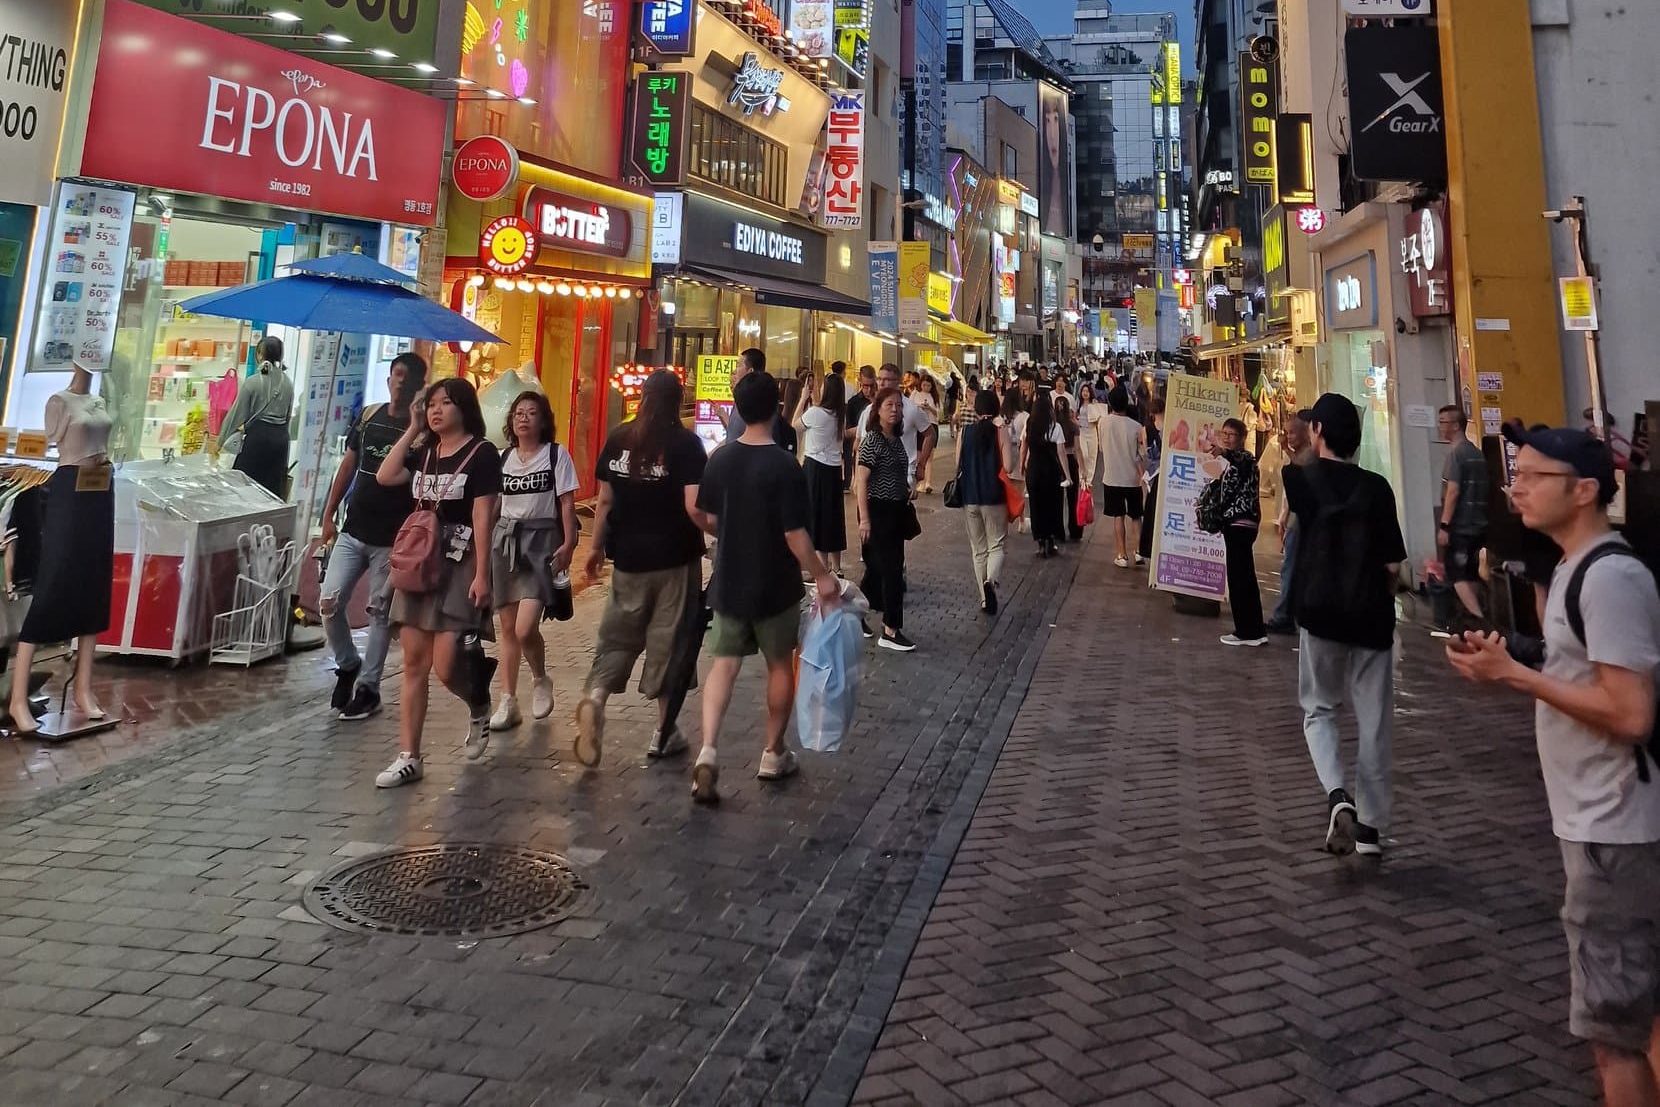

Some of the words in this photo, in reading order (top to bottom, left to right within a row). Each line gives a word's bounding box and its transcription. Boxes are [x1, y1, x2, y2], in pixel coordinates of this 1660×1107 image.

[639, 46, 653, 58] 1F
[648, 78, 676, 94] 루키
[1251, 68, 1270, 158] momo
[200, 75, 378, 182] EPONA
[646, 97, 671, 174] 노래방
[460, 158, 507, 171] EPONA
[827, 112, 861, 213] 부동산
[269, 178, 291, 193] since
[293, 182, 311, 196] 1982
[825, 216, 860, 225] 777-7727
[1300, 208, 1321, 231] 粥
[735, 222, 766, 258] EDIYA
[768, 231, 803, 264] COFFEE
[487, 258, 526, 273] BUTTER
[871, 260, 882, 317] EVENT
[880, 260, 888, 318] MYEONGDONG
[887, 281, 895, 317] SUMMER
[1175, 380, 1230, 404] Hikari
[1174, 396, 1231, 418] Massage
[1168, 455, 1197, 483] 足
[502, 472, 550, 492] VOGUE
[1165, 512, 1185, 532] 足
